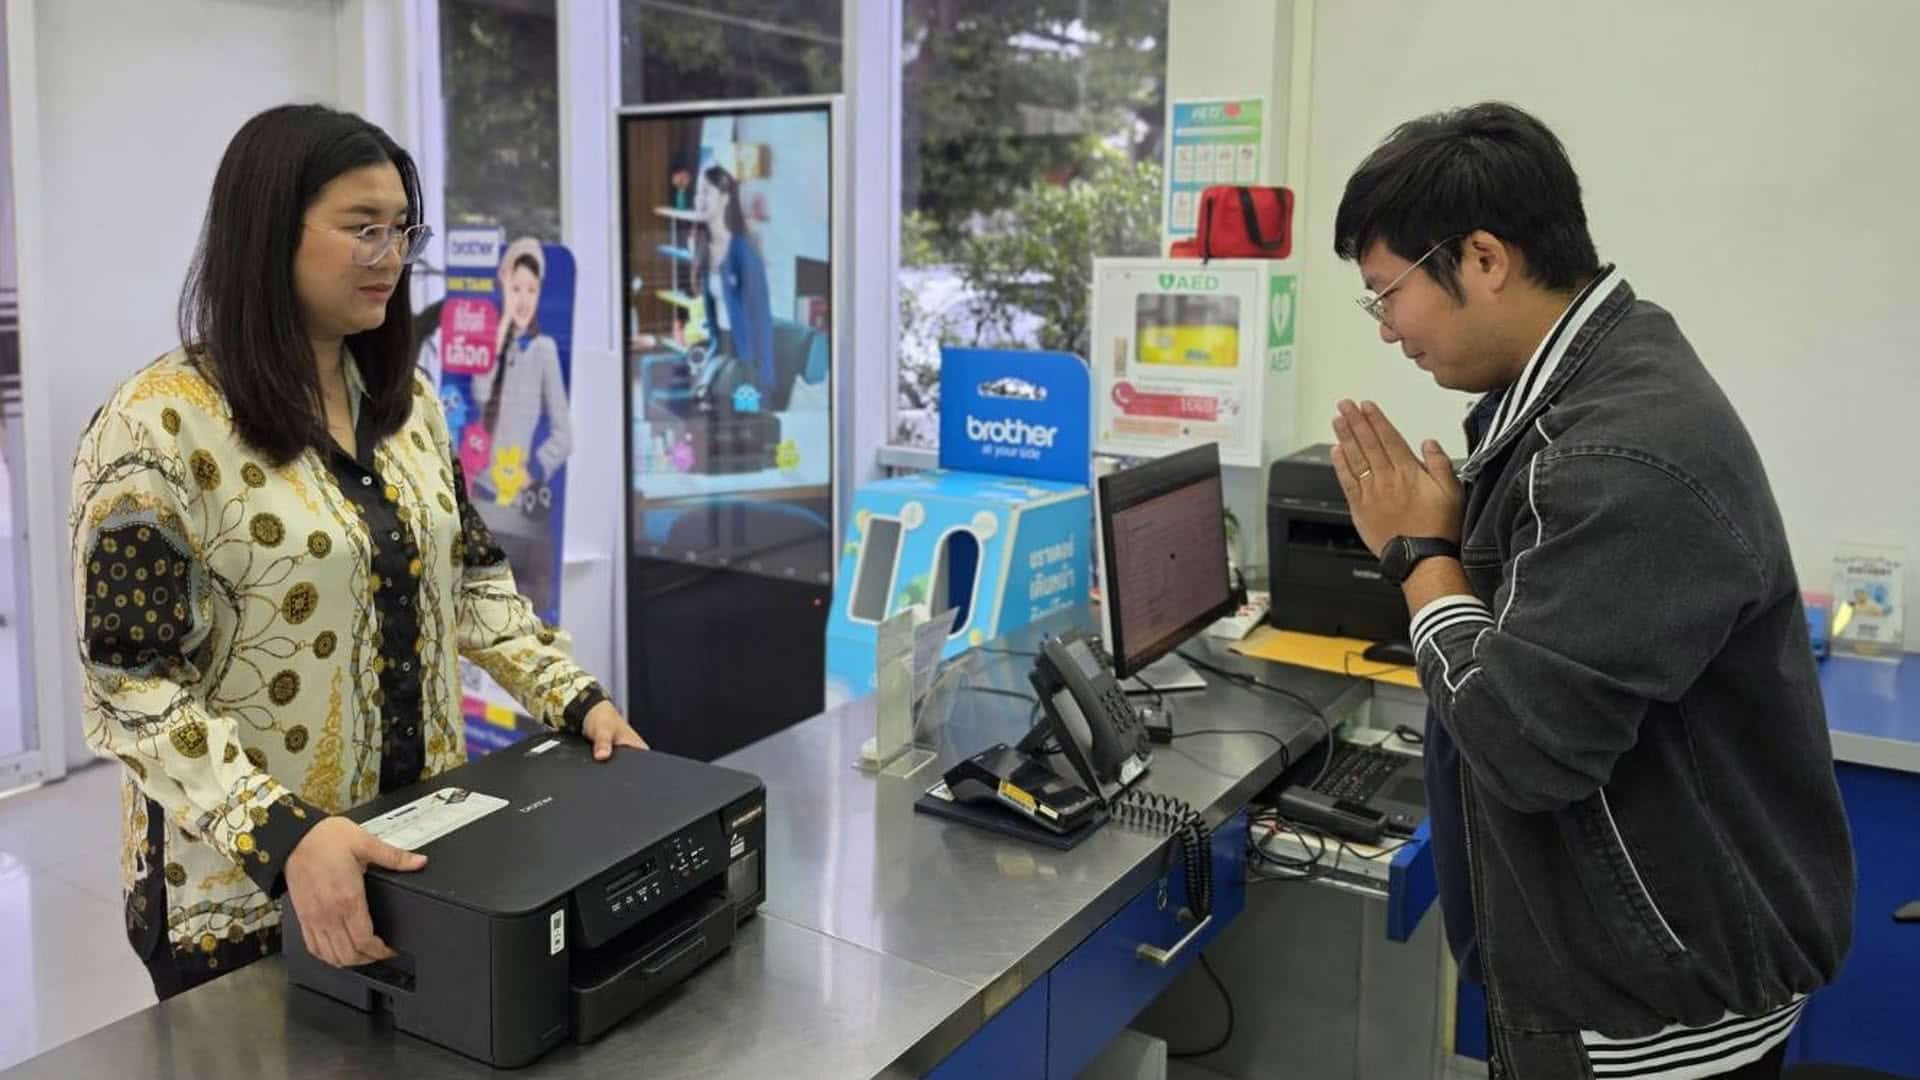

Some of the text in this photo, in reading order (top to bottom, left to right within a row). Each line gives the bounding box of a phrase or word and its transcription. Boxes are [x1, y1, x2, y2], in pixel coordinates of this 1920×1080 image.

[452, 239, 494, 255] brother
[1176, 276, 1219, 290] AED
[966, 414, 1058, 447] brother
[994, 446, 1018, 459] your
[1019, 446, 1041, 460] side
